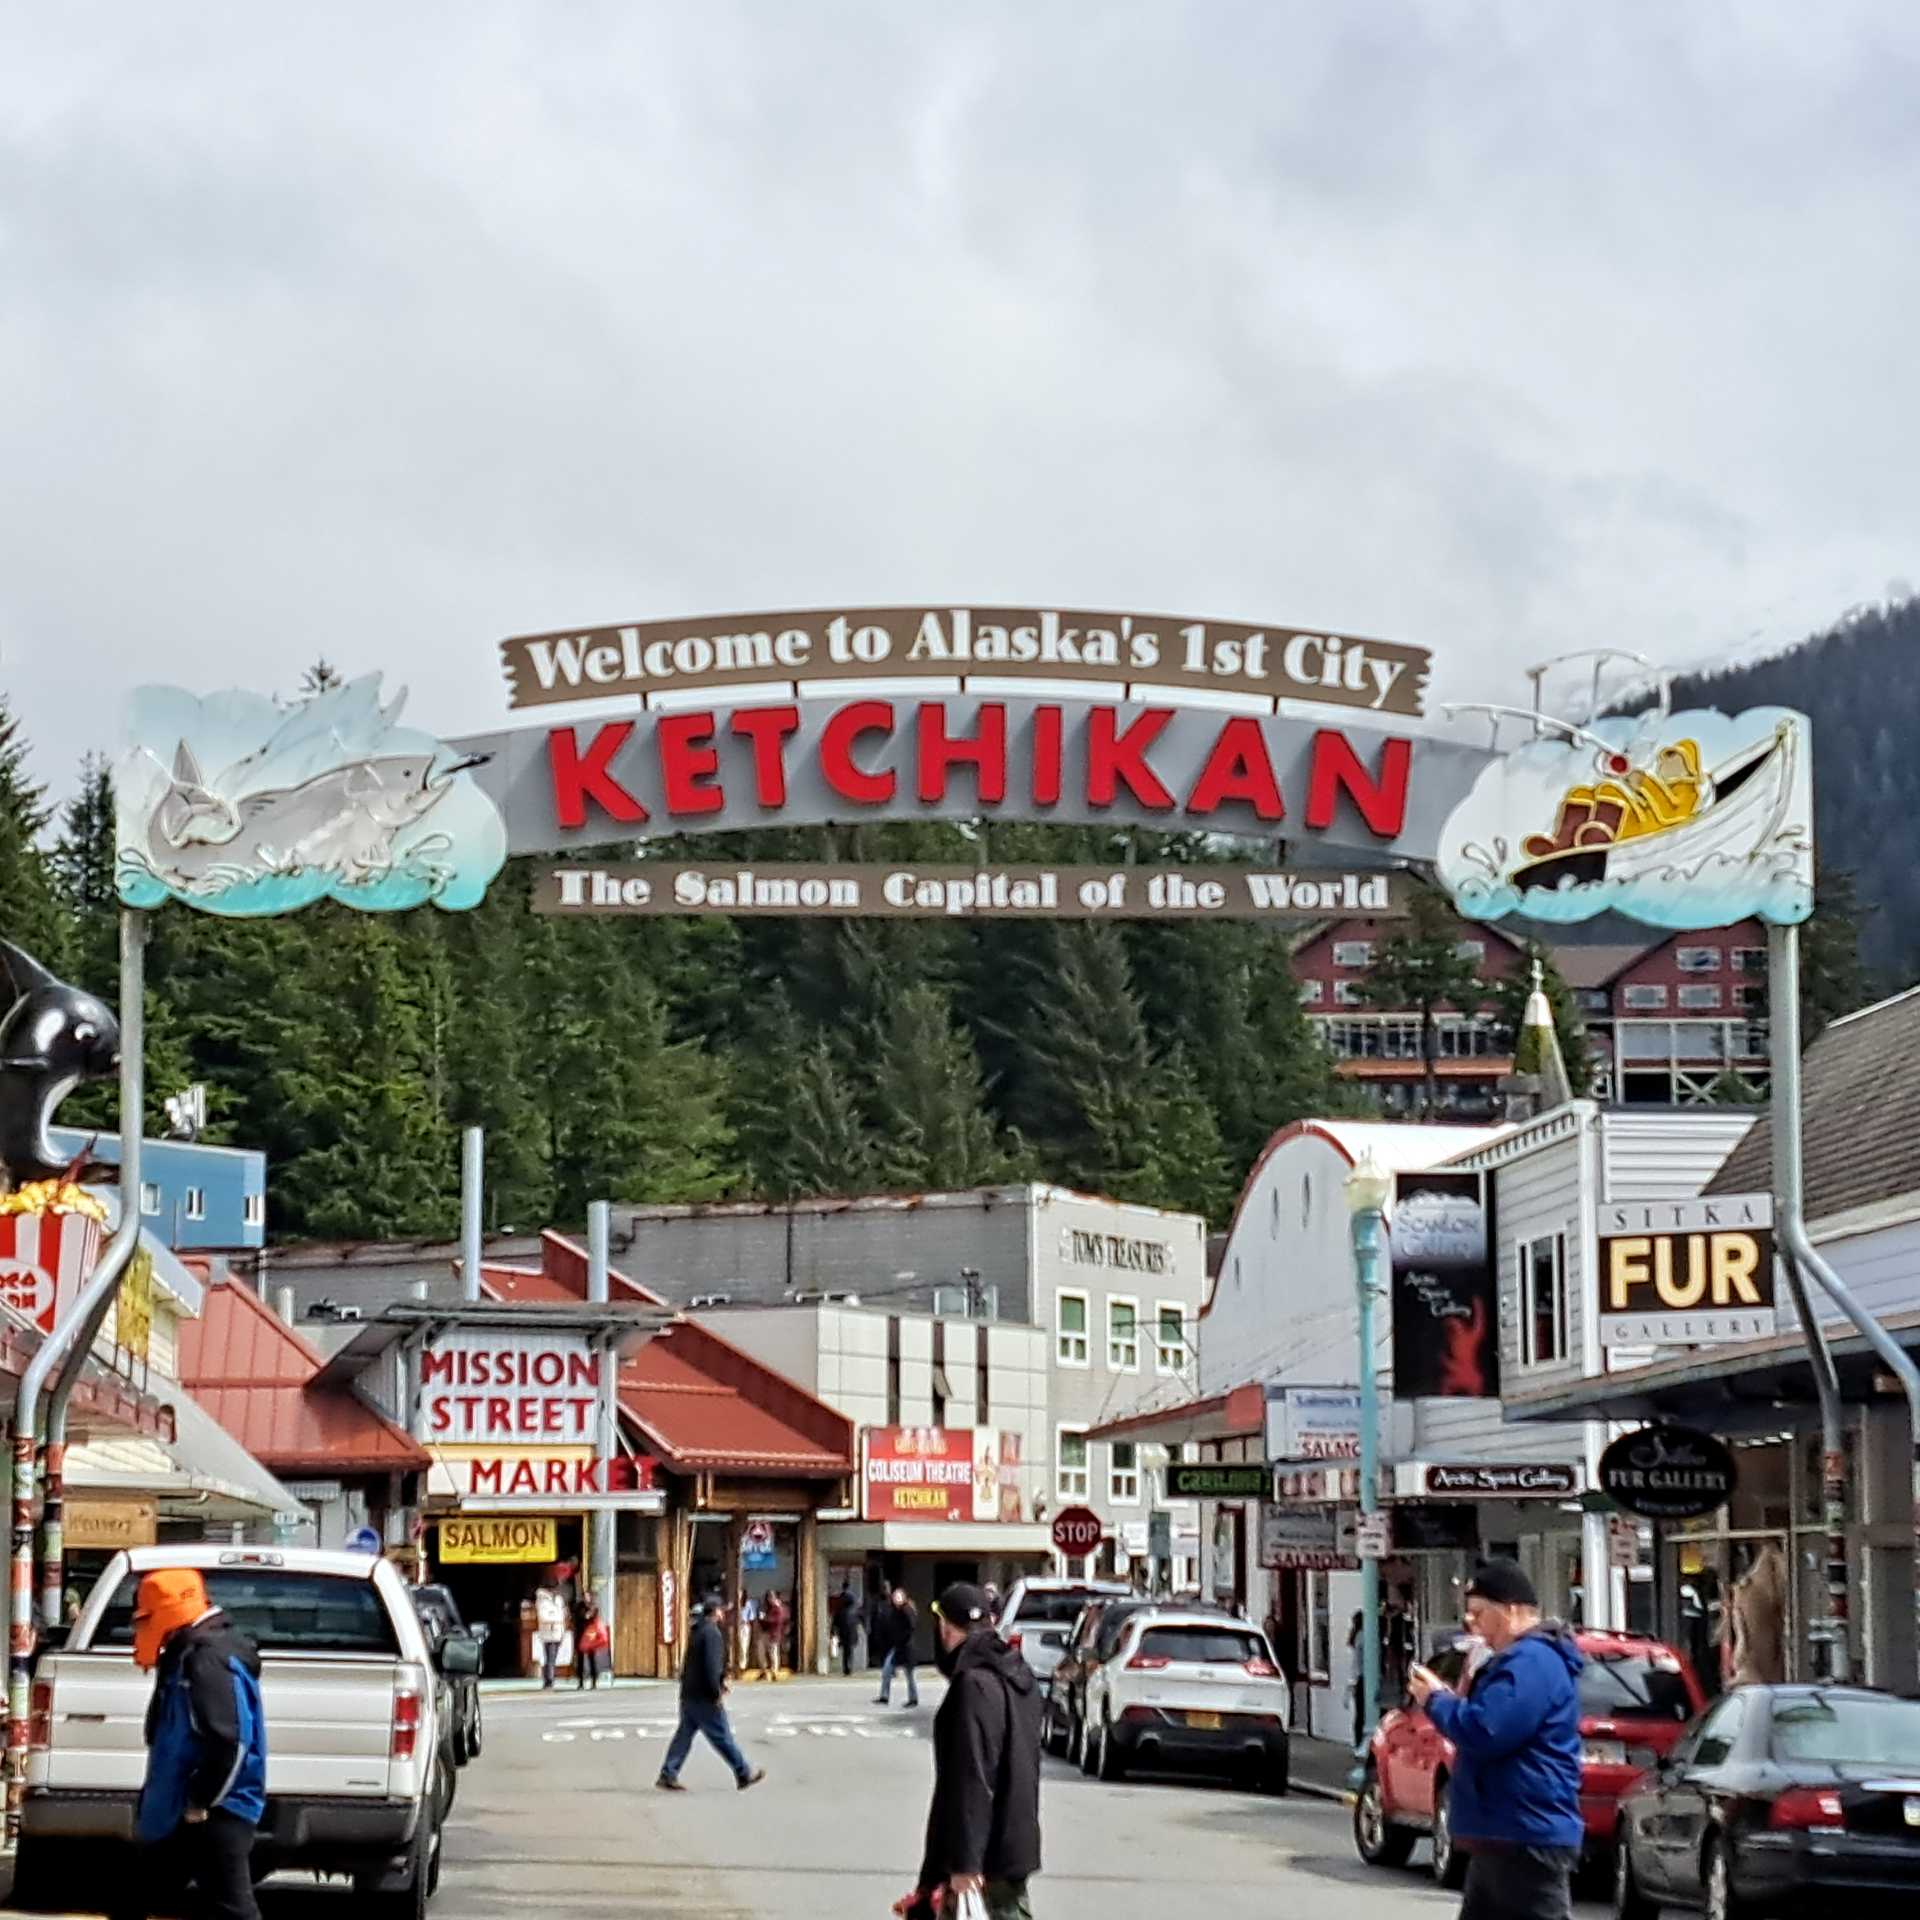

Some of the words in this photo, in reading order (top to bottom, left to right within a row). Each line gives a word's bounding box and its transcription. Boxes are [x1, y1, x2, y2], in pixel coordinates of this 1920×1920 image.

[525, 628, 812, 690] Welcome
[825, 615, 892, 663] to
[905, 609, 1160, 668] Alaska's
[1178, 624, 1269, 679] 1st
[1283, 634, 1407, 709] City
[548, 700, 1412, 839] KETCHIKAN
[551, 869, 652, 906] The
[674, 870, 860, 907] Salmon
[883, 871, 1057, 914] Capital
[1079, 873, 1127, 912] of
[1147, 874, 1226, 908] the
[1245, 874, 1389, 910] World
[1614, 1203, 1755, 1231] SITKA
[1610, 1232, 1762, 1309] FUR
[1615, 1319, 1764, 1339] GALLERY
[420, 1351, 600, 1387] MISSION
[431, 1397, 595, 1433] STREET
[469, 1456, 660, 1495] MARKET
[868, 1459, 923, 1483] COLISEUM
[924, 1460, 972, 1485] THEATRE
[1608, 1469, 1645, 1489] FUR
[1649, 1469, 1727, 1491] GALLERY
[446, 1523, 547, 1548] SALMON
[1055, 1521, 1099, 1543] STOP
